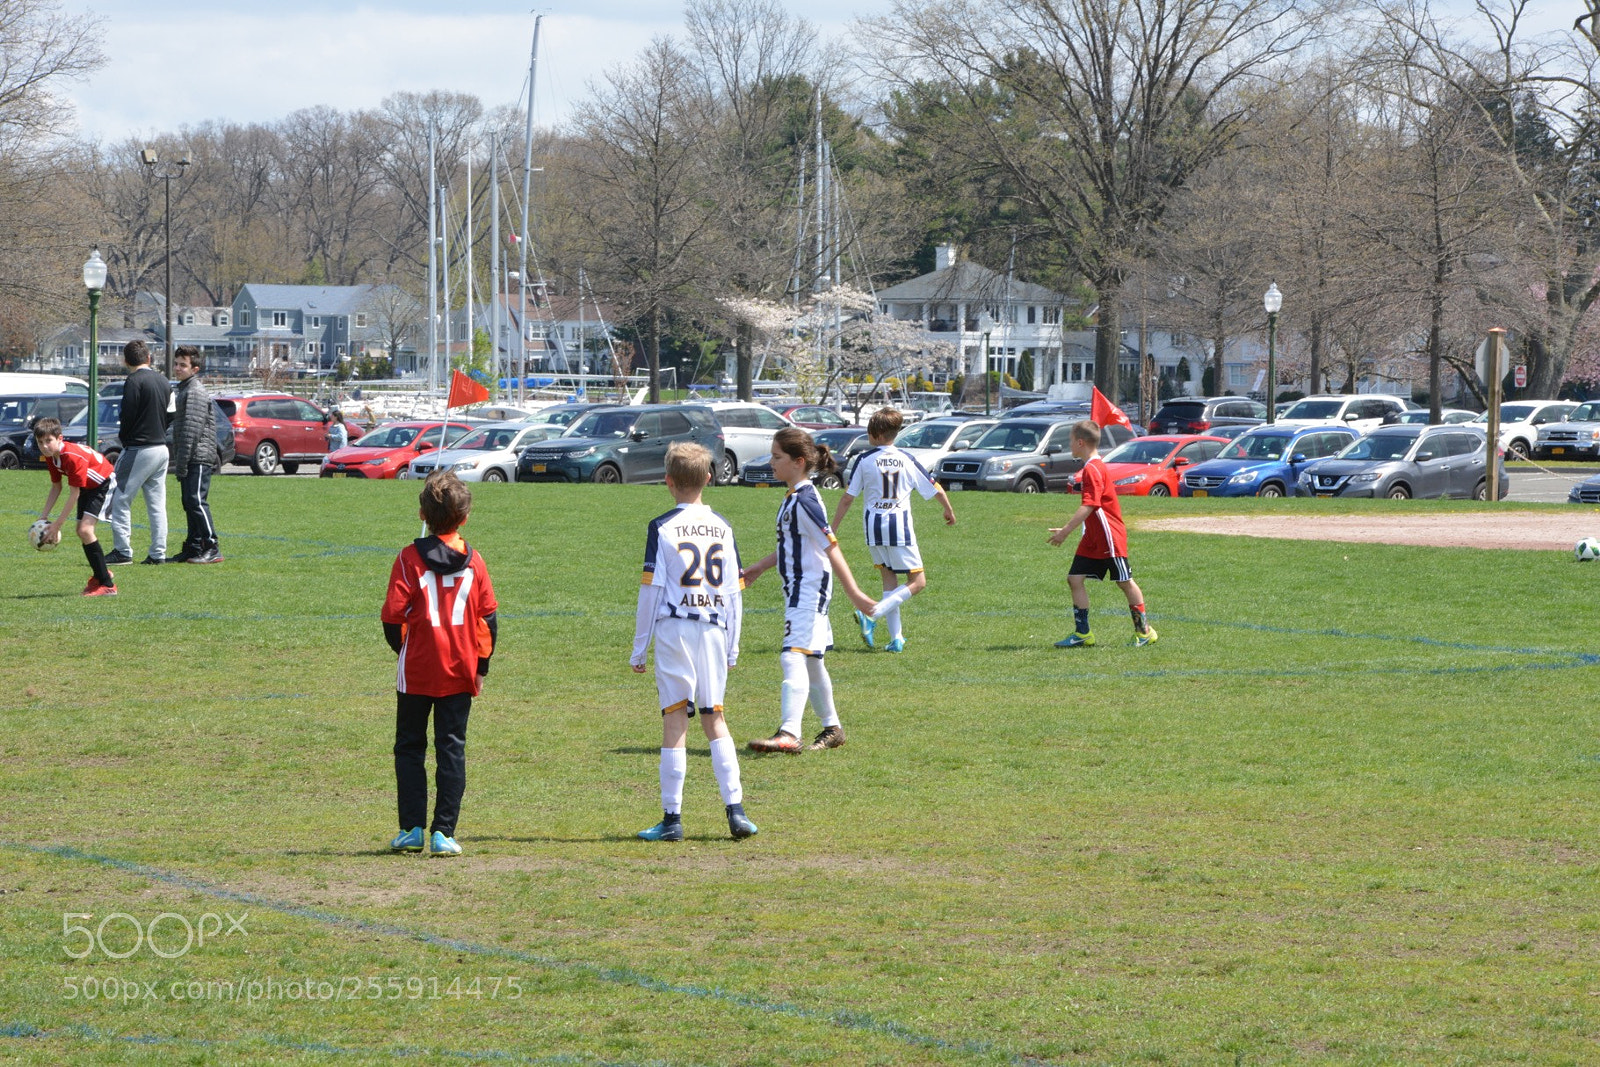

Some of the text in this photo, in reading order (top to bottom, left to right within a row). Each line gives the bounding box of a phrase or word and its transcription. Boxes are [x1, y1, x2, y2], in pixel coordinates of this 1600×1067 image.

[876, 458, 904, 468] WILSON
[881, 470, 900, 499] 11
[674, 525, 726, 540] TKACHEV
[678, 541, 725, 588] 26
[419, 568, 474, 627] 17
[680, 593, 712, 607] ALBA
